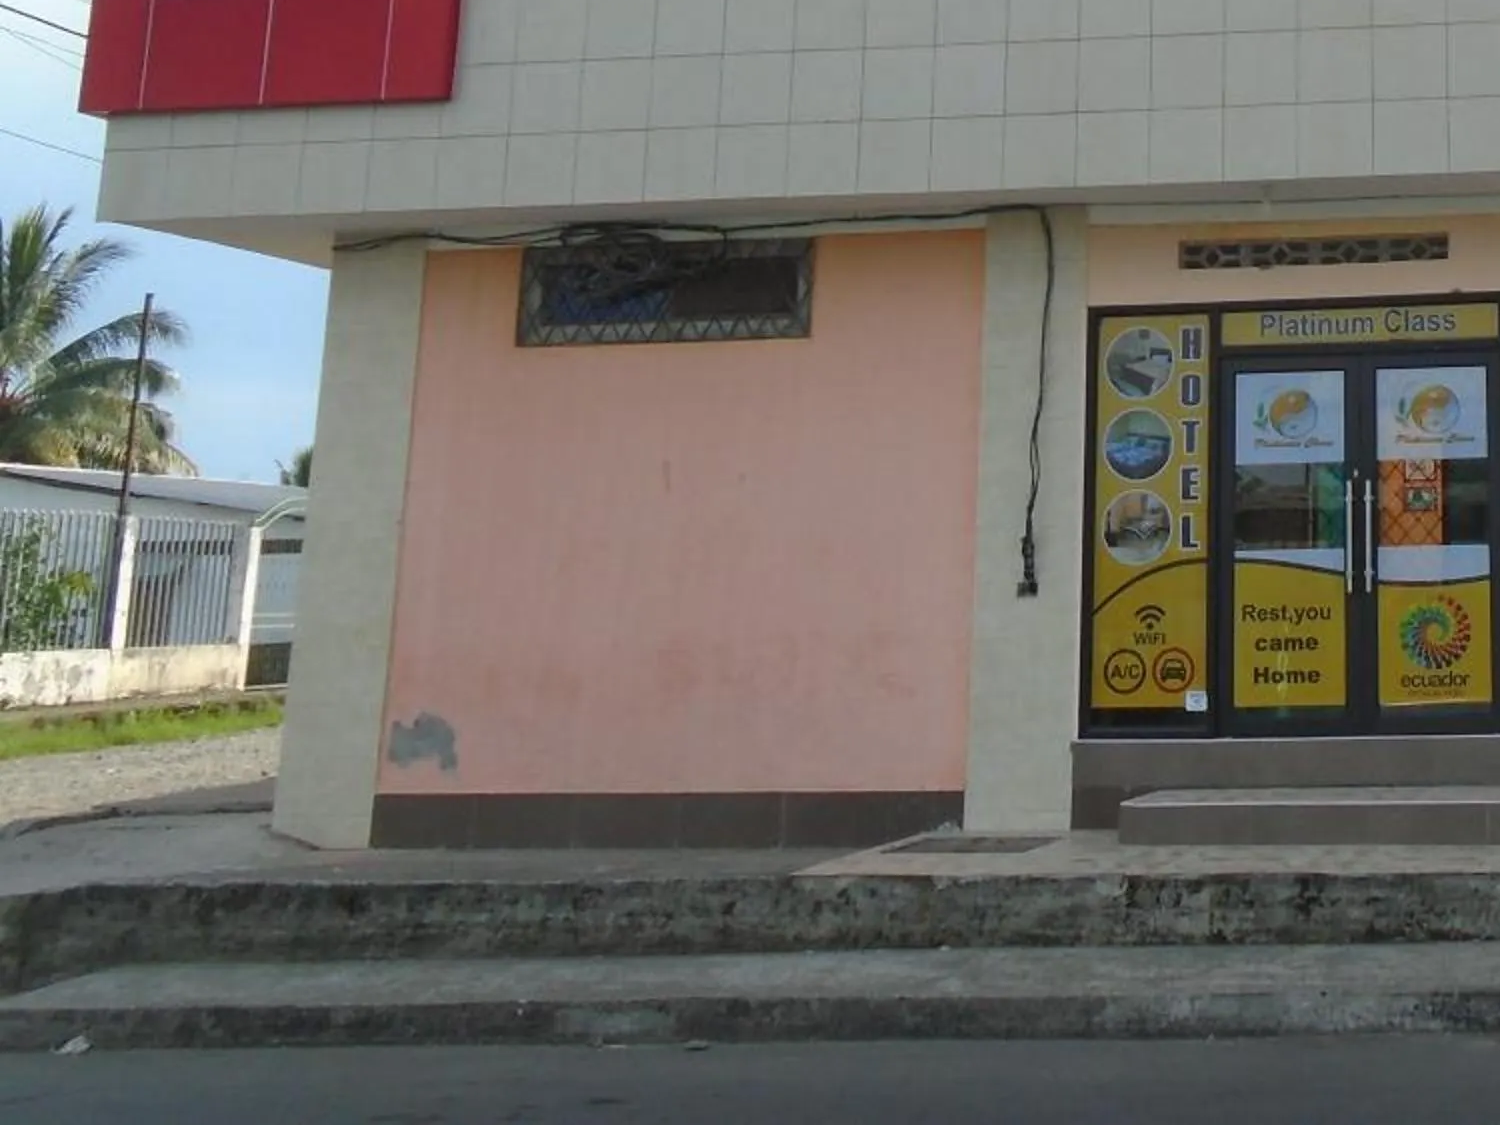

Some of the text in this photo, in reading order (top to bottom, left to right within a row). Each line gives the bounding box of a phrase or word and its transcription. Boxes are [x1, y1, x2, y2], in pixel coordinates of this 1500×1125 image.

[1258, 309, 1457, 337] Platinum Class
[1181, 326, 1202, 549] HOTEL
[1254, 635, 1320, 652] came
[1110, 663, 1141, 680] A/C
[1252, 666, 1321, 685] Home
[1400, 670, 1471, 688] ecuador
